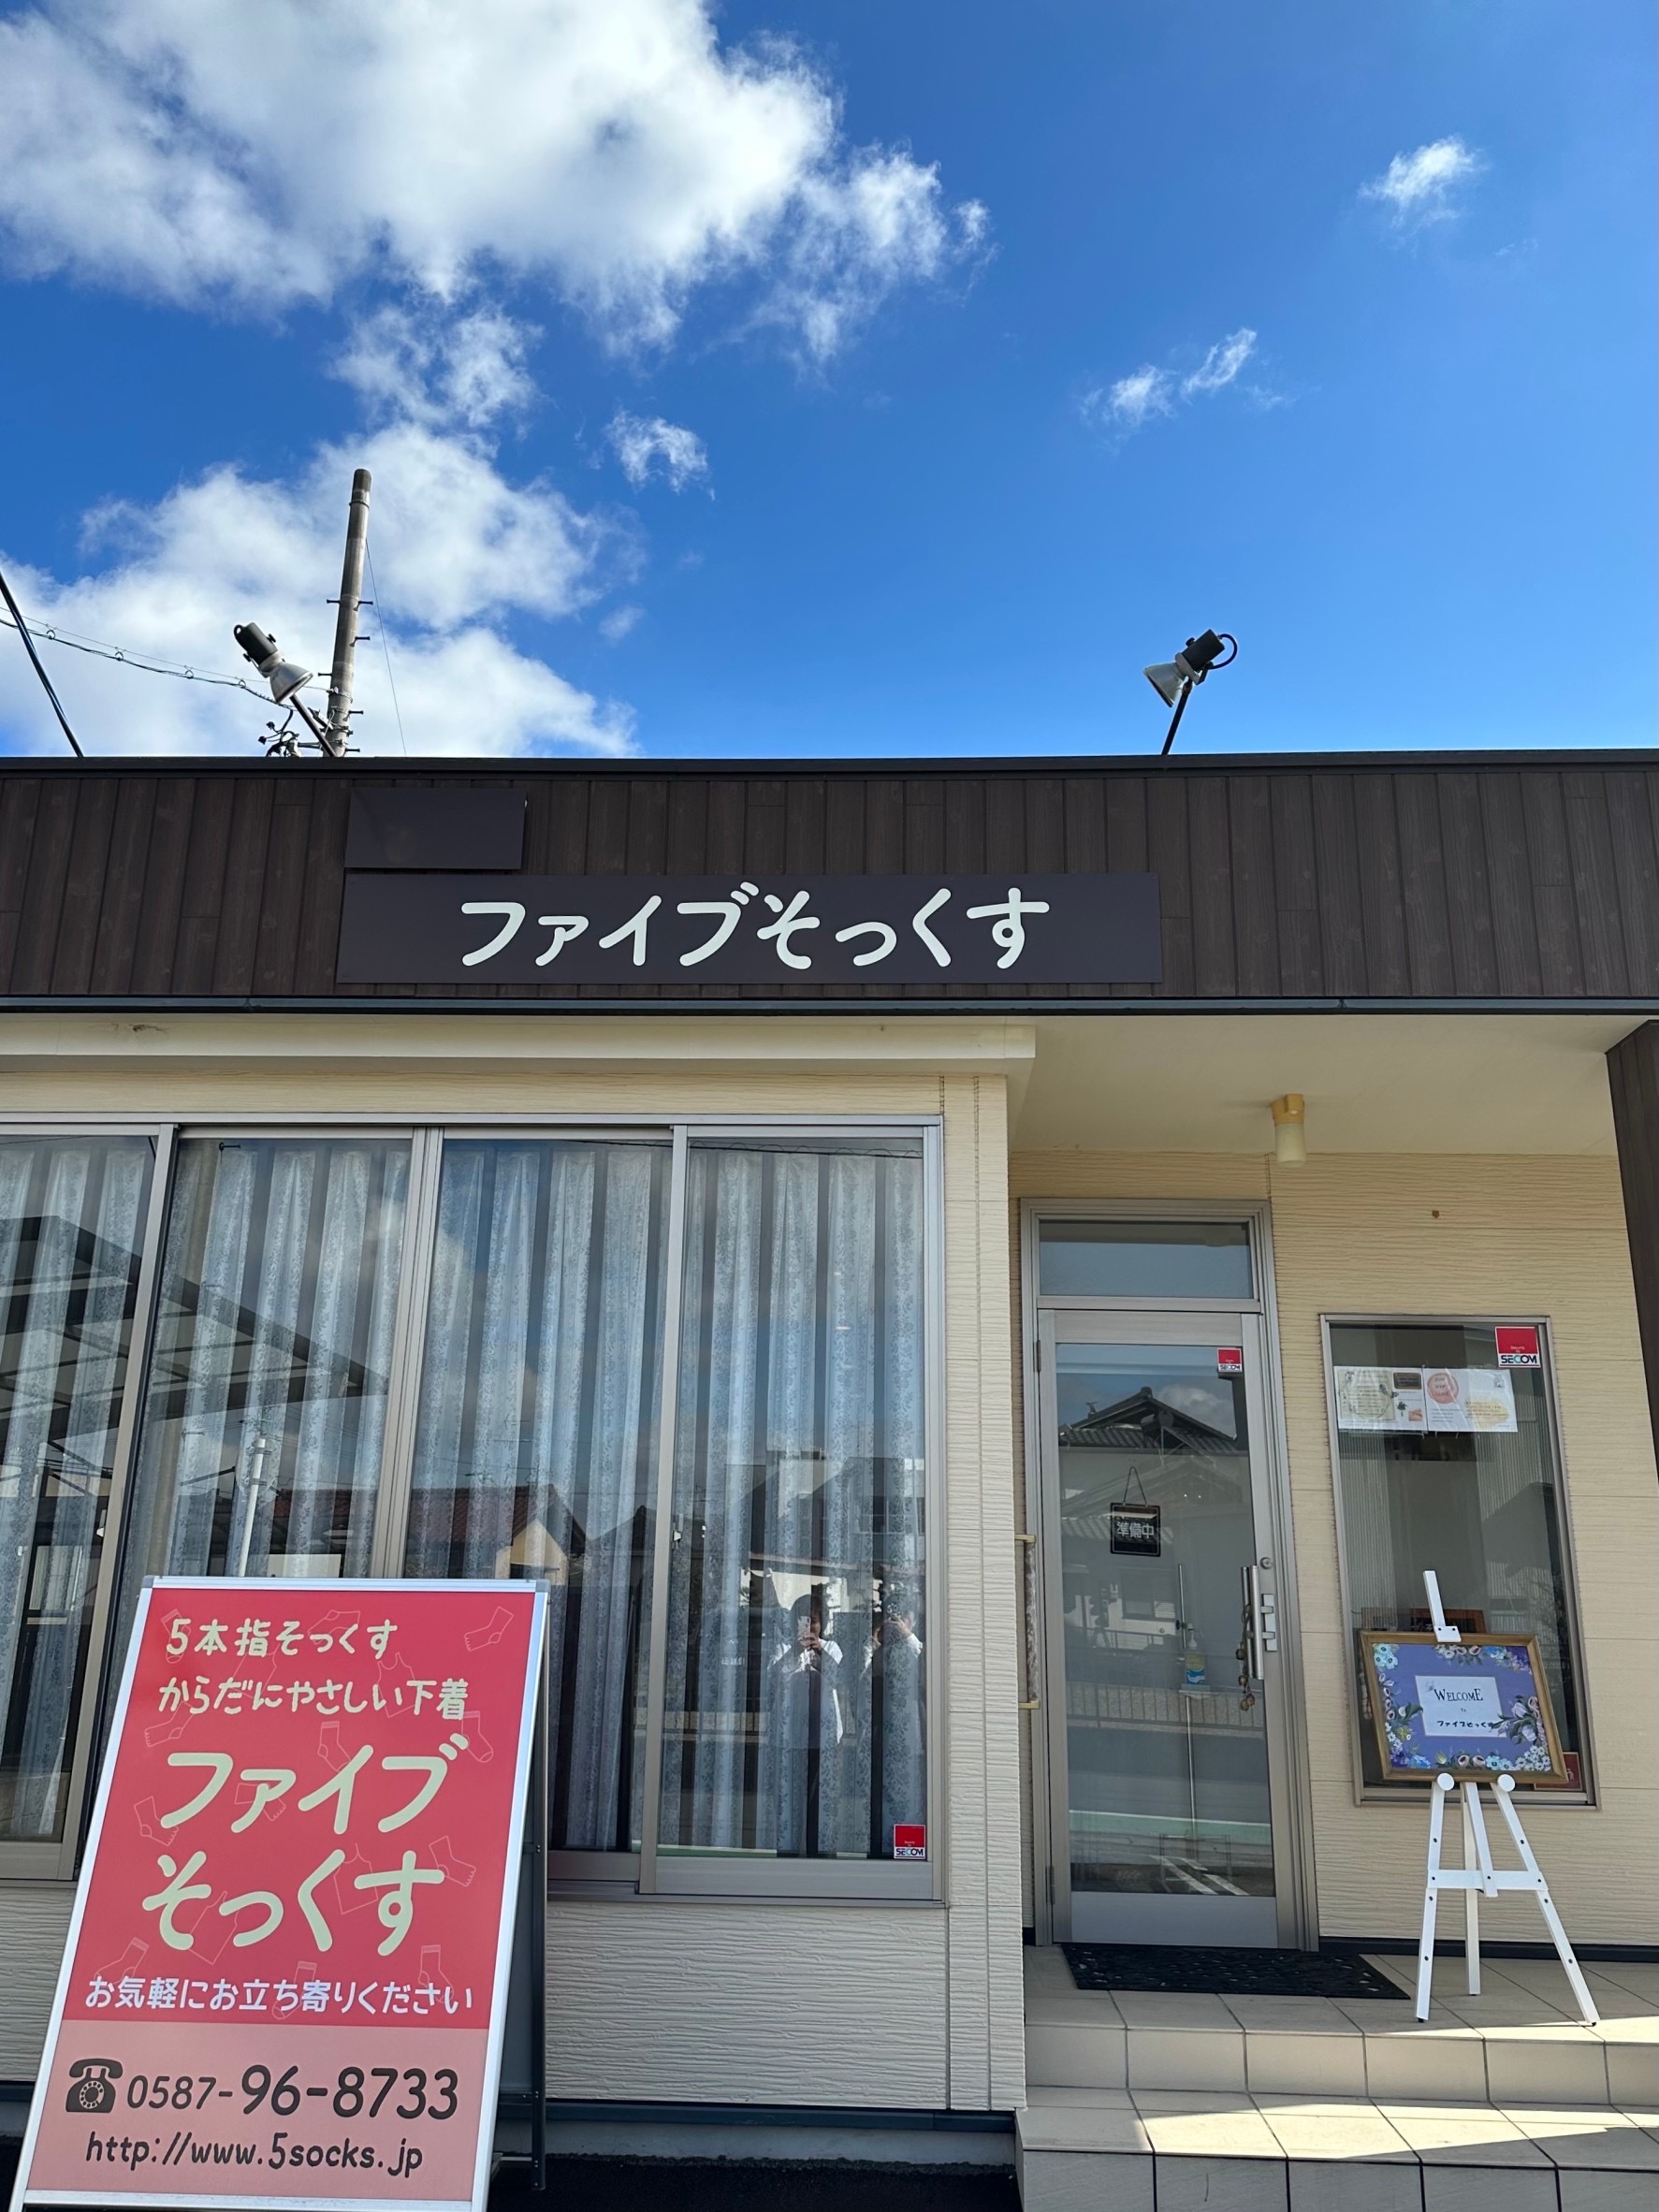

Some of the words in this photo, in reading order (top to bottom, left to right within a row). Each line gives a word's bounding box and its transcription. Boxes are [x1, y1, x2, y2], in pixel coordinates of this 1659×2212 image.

[460, 881, 1050, 969] ファイブそっくす
[1501, 1354, 1537, 1364] SECOM
[1116, 1521, 1155, 1539] 準備中
[166, 1618, 398, 1660] 5本指そっくす
[158, 1675, 469, 1721] からだにやさしい下着
[160, 1733, 469, 1835] ファイブ
[895, 1848, 924, 1856] SECOM
[141, 1849, 445, 1957] そっくす
[85, 1975, 472, 2015] お気軽にお立ち寄りください
[127, 2064, 458, 2120] 0587-96-8733
[85, 2131, 423, 2178] http://www.5socks.jp
